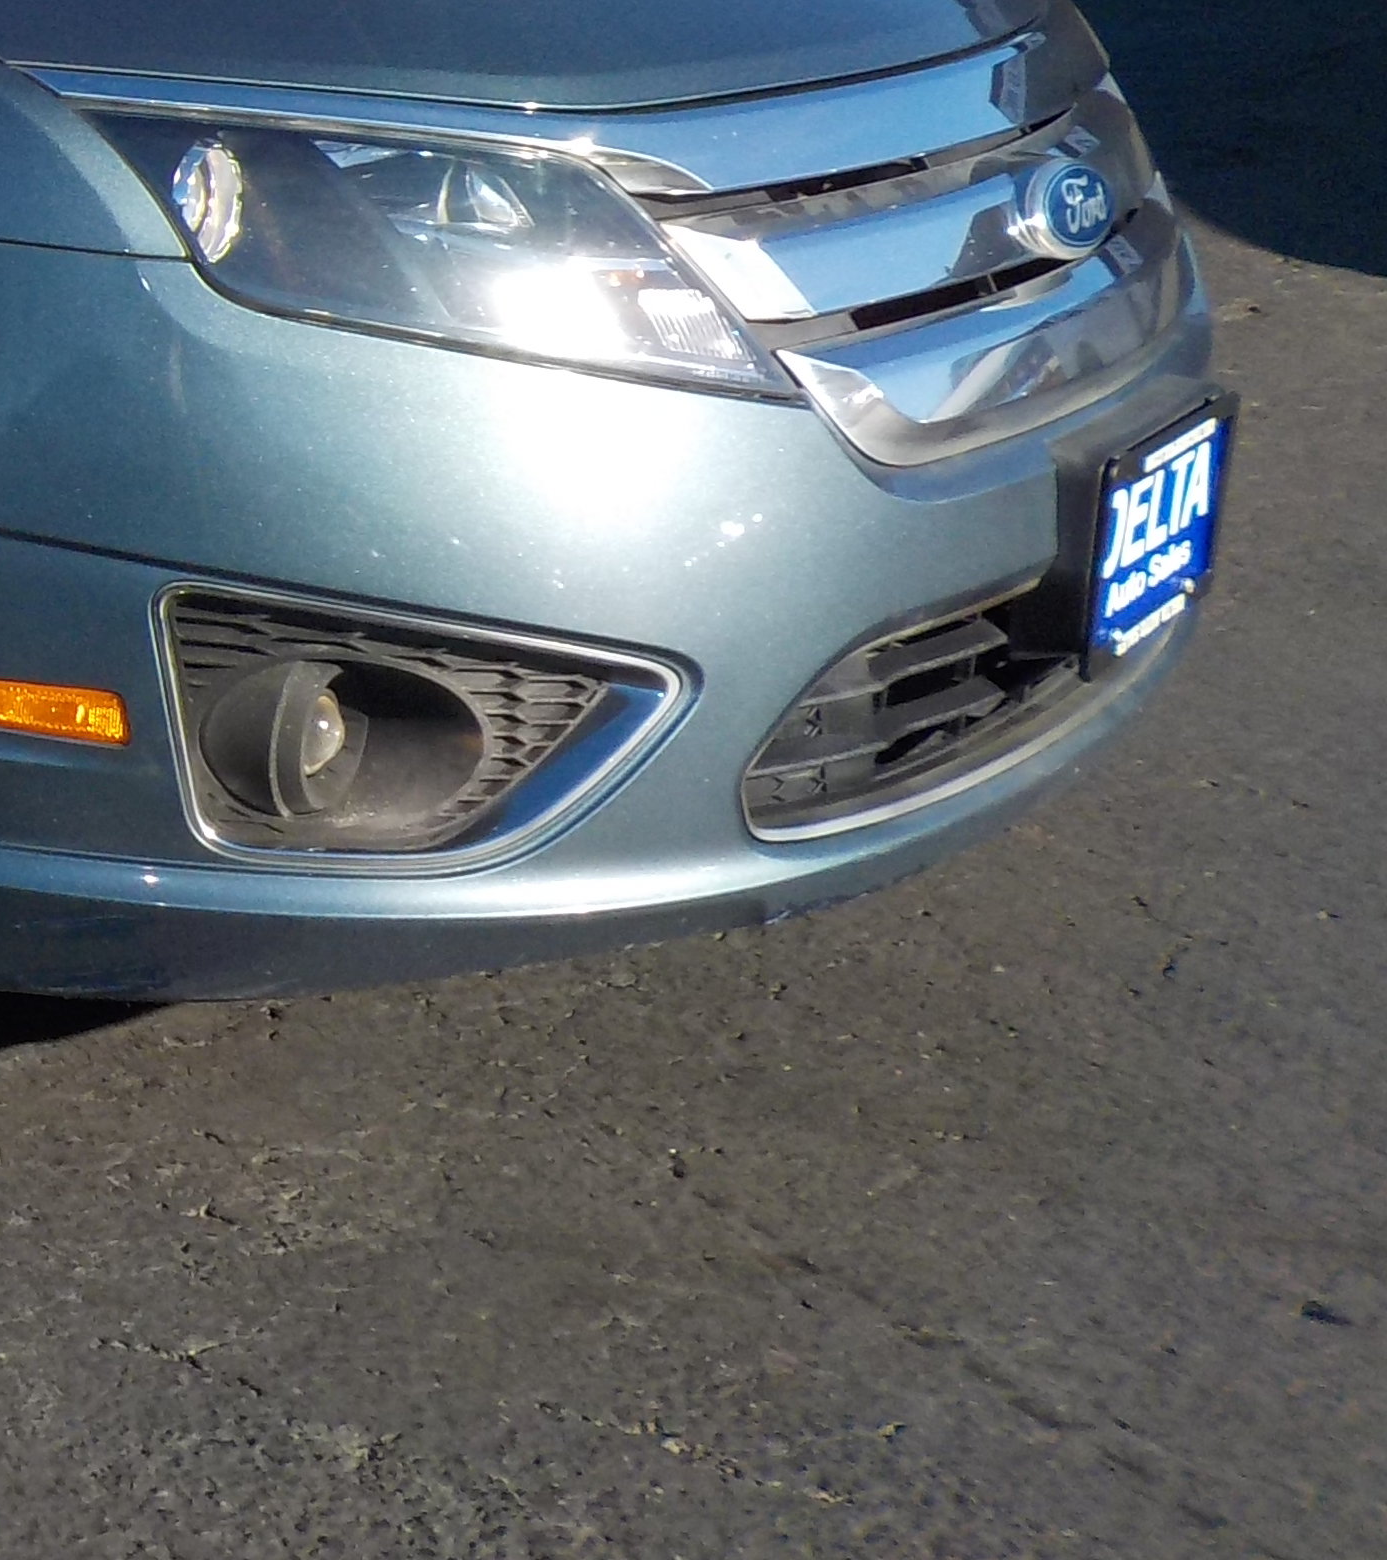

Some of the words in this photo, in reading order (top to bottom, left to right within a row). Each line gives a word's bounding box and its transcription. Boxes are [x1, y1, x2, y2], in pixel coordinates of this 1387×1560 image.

[1061, 174, 1107, 235] Ford
[1105, 570, 1147, 618] Auto
[1147, 540, 1192, 588] Sales
